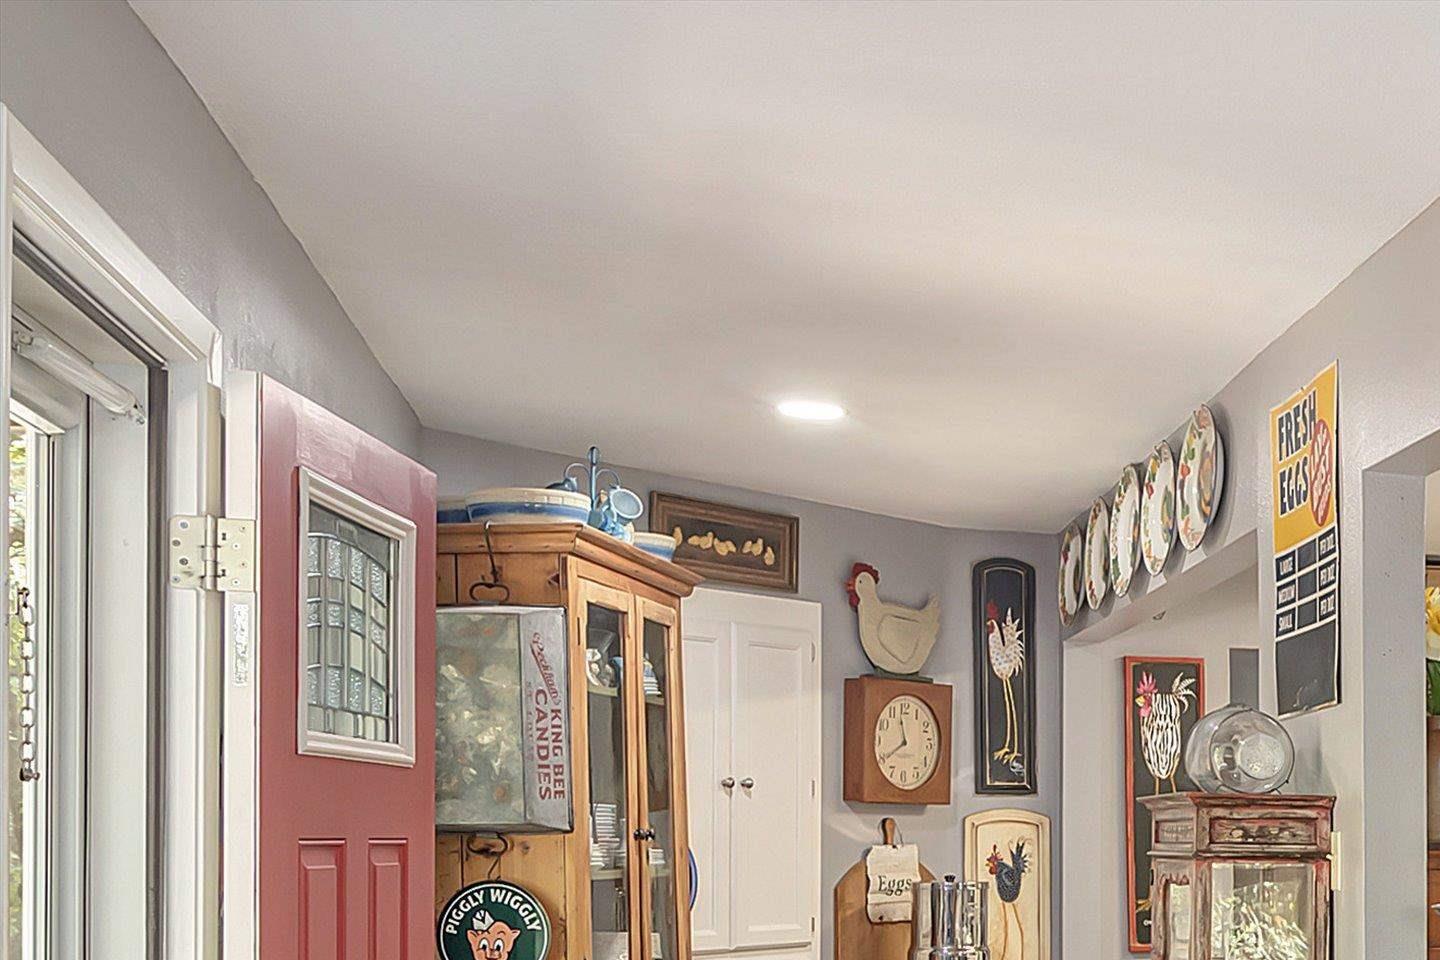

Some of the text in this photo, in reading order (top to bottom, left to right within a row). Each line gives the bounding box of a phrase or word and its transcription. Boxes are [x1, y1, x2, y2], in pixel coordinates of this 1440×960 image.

[1278, 389, 1317, 462] FRESH
[1279, 456, 1308, 516] EGGS
[889, 706, 896, 718] 11
[900, 703, 910, 716] 12
[915, 708, 919, 720] 1
[922, 721, 929, 733] 2
[535, 688, 552, 801] CANDIES
[551, 708, 566, 800] KING BEE
[889, 765, 896, 778] 7
[900, 770, 906, 783] 6
[878, 875, 912, 897] Eggs
[445, 888, 542, 935] PIGGLY WIGGLY
